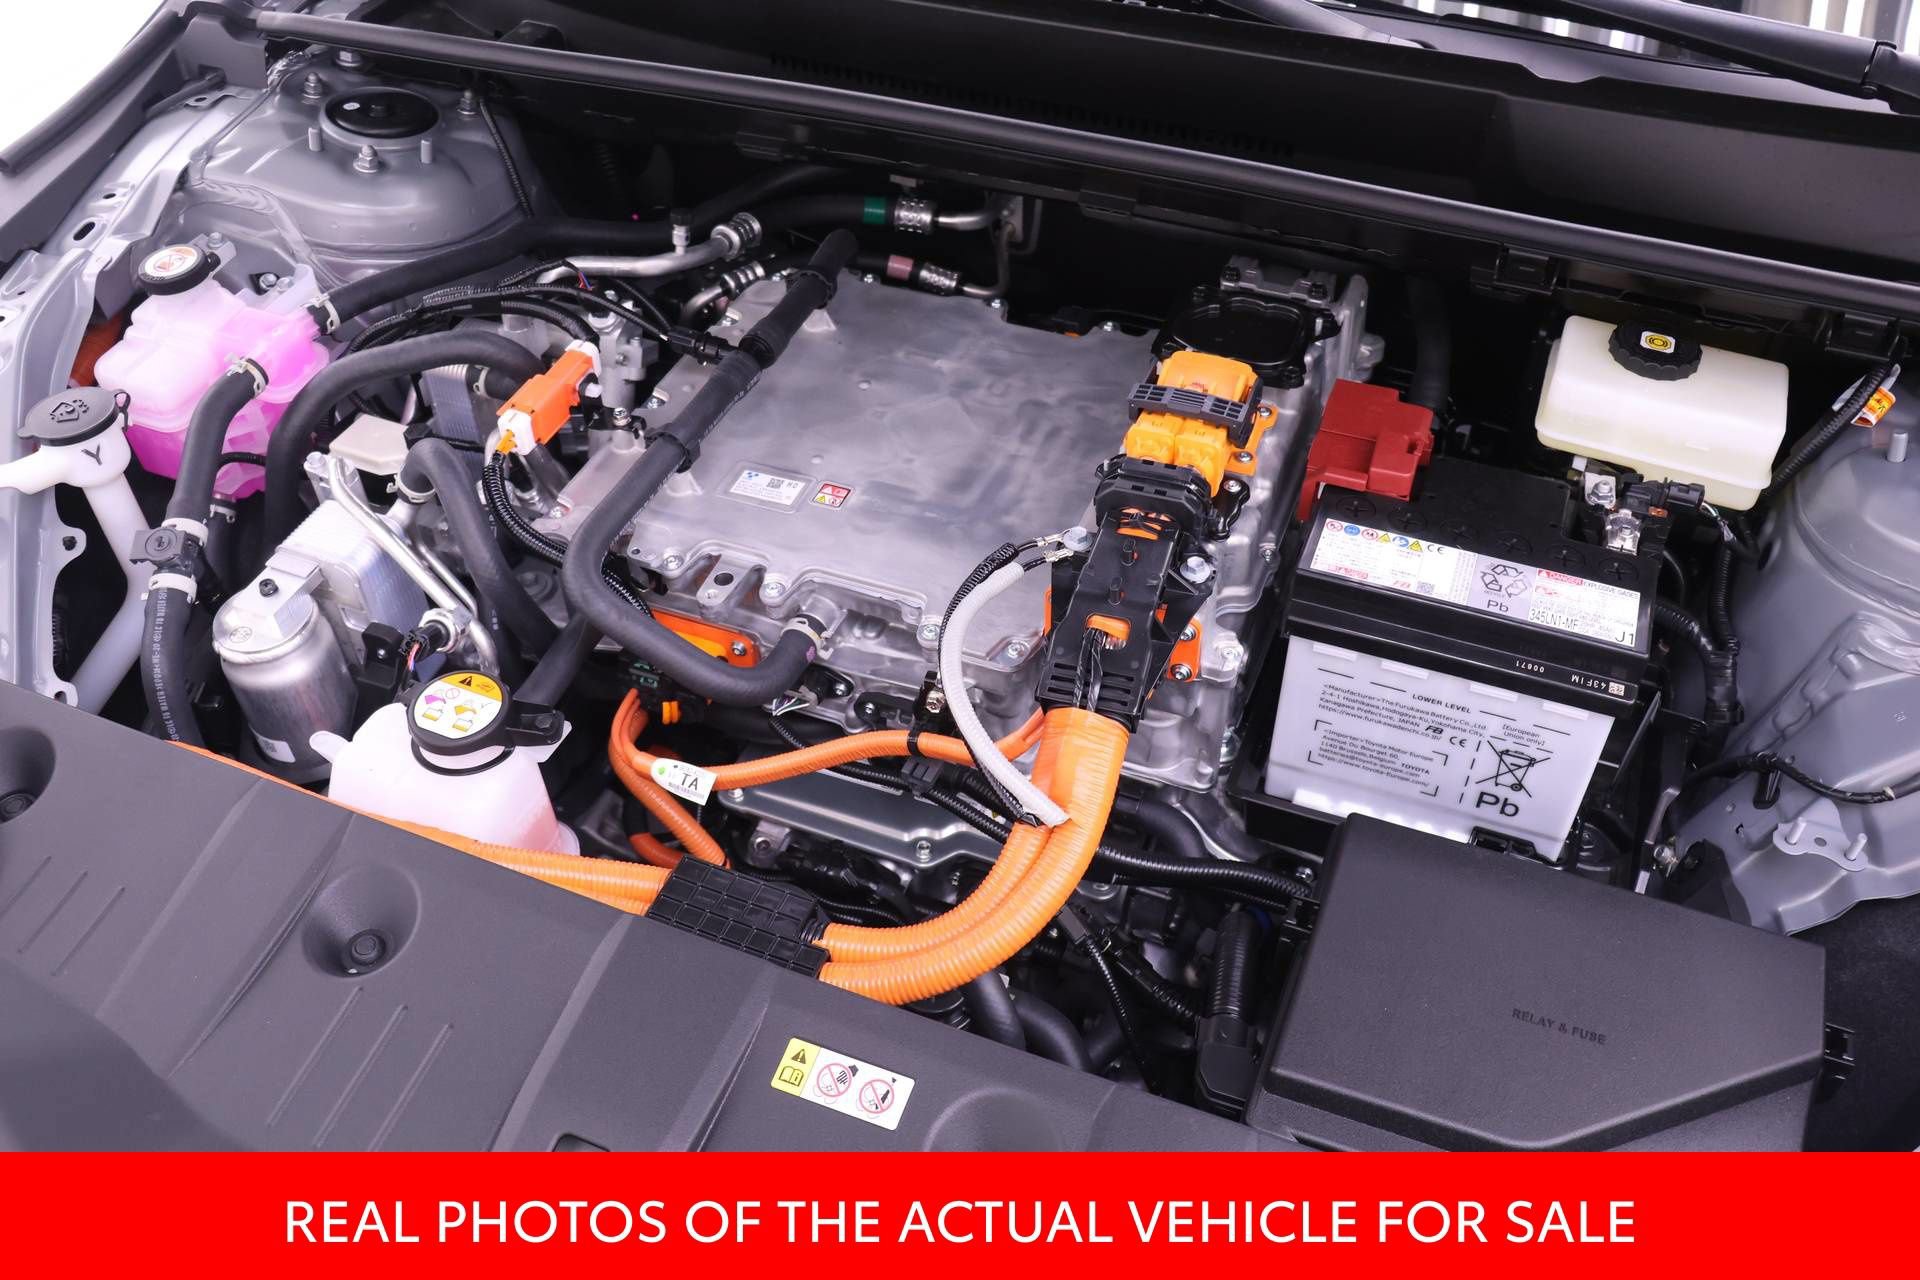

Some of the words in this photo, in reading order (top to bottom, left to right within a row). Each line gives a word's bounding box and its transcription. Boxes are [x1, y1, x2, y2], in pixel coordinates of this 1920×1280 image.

[1487, 599, 1509, 613] Pb
[1615, 631, 1634, 646] J1
[1320, 689, 1340, 699] 2-4-1
[1412, 693, 1443, 706] LOWER
[1444, 700, 1471, 713] LEVEL
[1397, 717, 1420, 727] JAPAN
[1400, 762, 1430, 774] TOYOTA
[681, 772, 699, 791] TA
[1476, 791, 1519, 817] Pb
[1511, 1008, 1556, 1028] RELAY
[1558, 1023, 1567, 1034] &
[1571, 1026, 1607, 1045] FUSE
